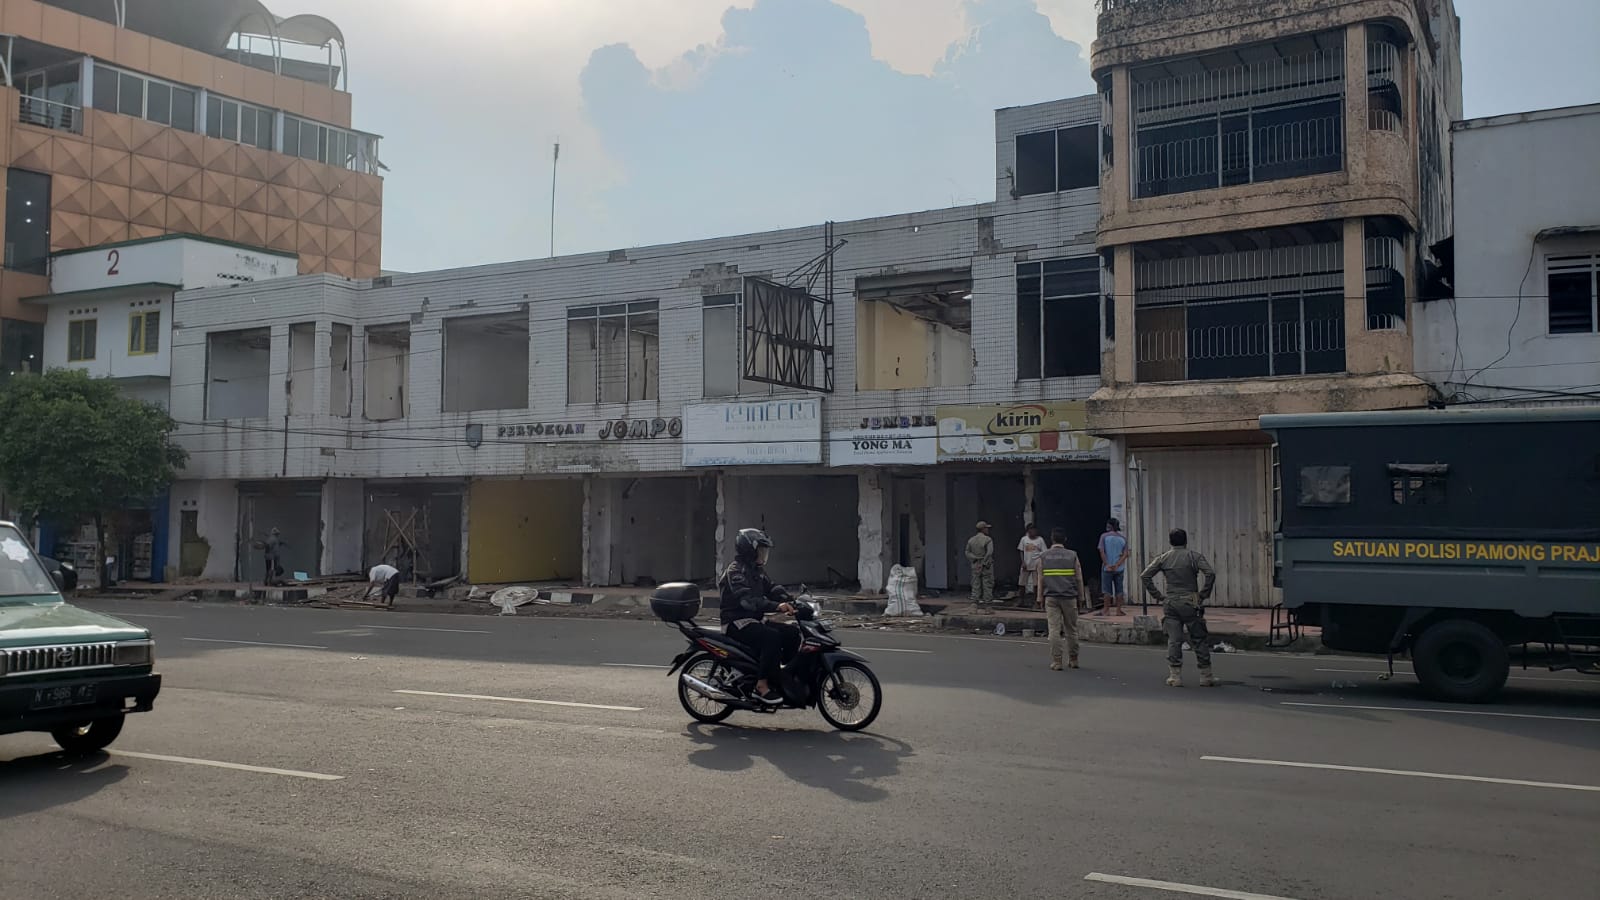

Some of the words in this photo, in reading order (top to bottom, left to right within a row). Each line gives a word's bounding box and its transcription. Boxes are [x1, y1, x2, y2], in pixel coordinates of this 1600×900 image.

[107, 249, 120, 276] 2
[599, 416, 683, 440] JOMPO
[996, 412, 1041, 427] kirin
[852, 440, 888, 450] YONG
[892, 440, 913, 449] MA
[1333, 541, 1399, 558] SATUAN
[1405, 542, 1460, 559] POLISI
[1465, 543, 1545, 561] PAMONG
[1551, 545, 1600, 562] PRAJ
